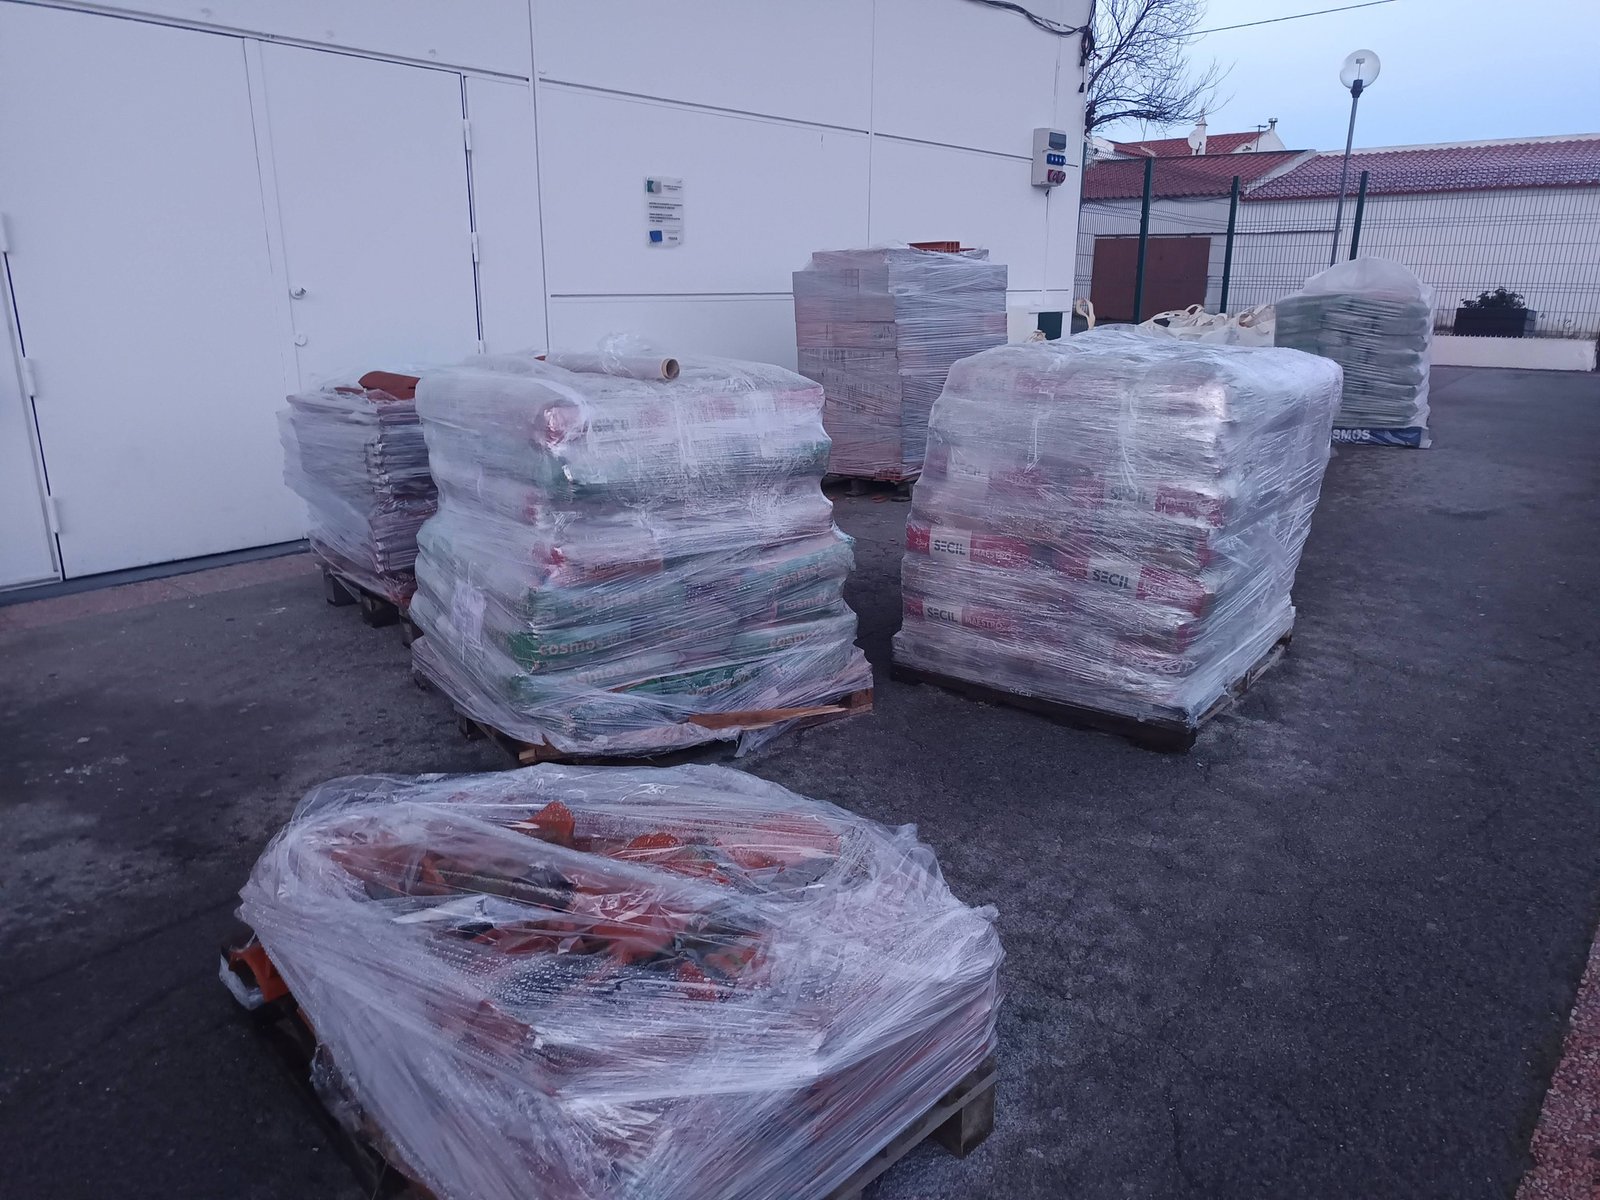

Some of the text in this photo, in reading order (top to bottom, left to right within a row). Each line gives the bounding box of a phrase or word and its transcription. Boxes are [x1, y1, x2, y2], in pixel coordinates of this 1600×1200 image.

[934, 539, 966, 556] SECIL
[1092, 569, 1132, 590] SECIL
[927, 607, 960, 623] SECIL
